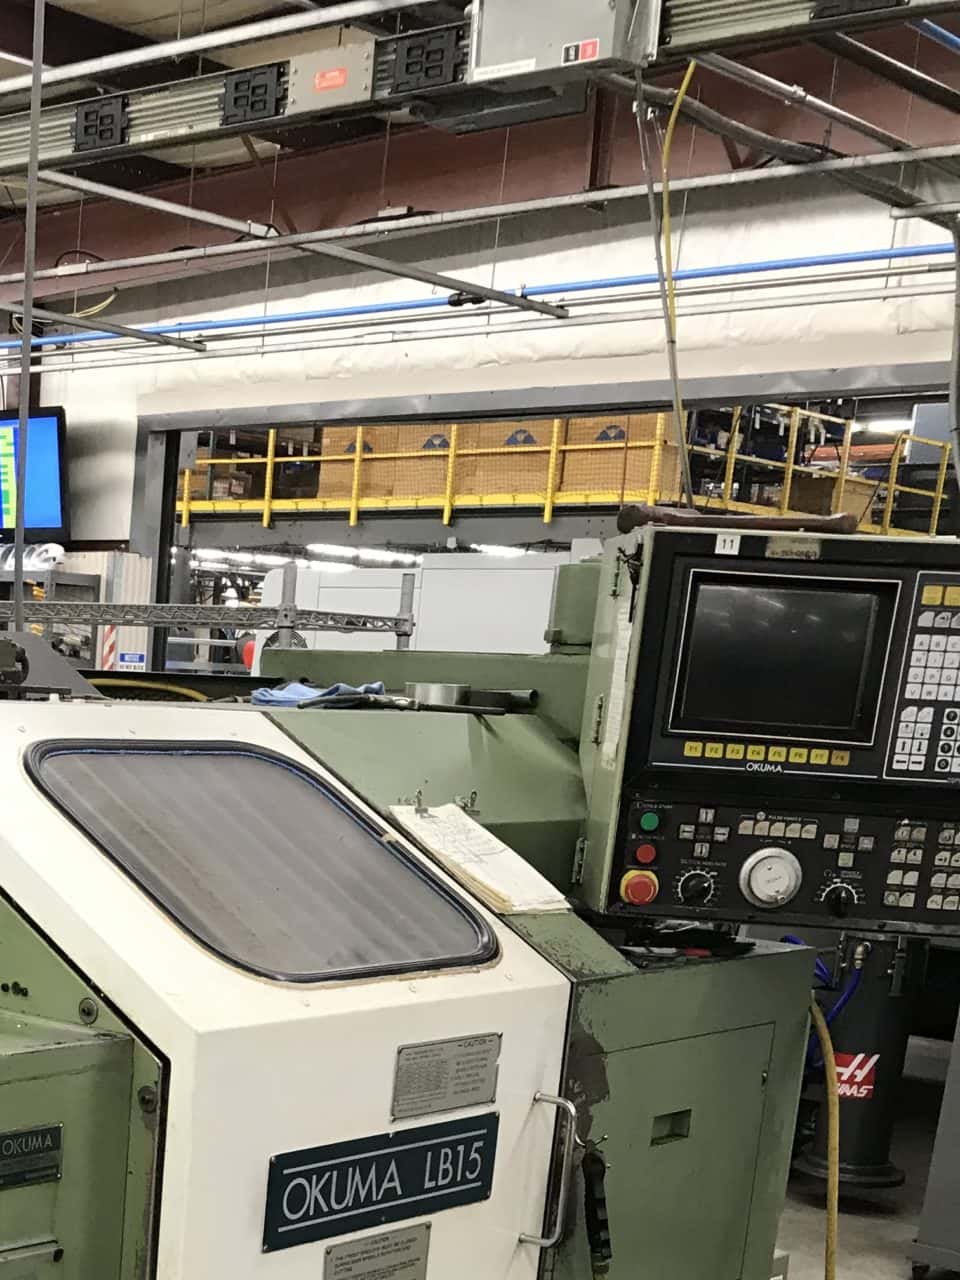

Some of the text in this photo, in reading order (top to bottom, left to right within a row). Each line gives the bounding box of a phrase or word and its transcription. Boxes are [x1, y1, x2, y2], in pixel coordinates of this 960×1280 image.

[722, 538, 734, 550] 11
[746, 762, 783, 773] OKUMA
[1, 1134, 53, 1156] OKUMA
[282, 1141, 485, 1220] OKUMA LB15
